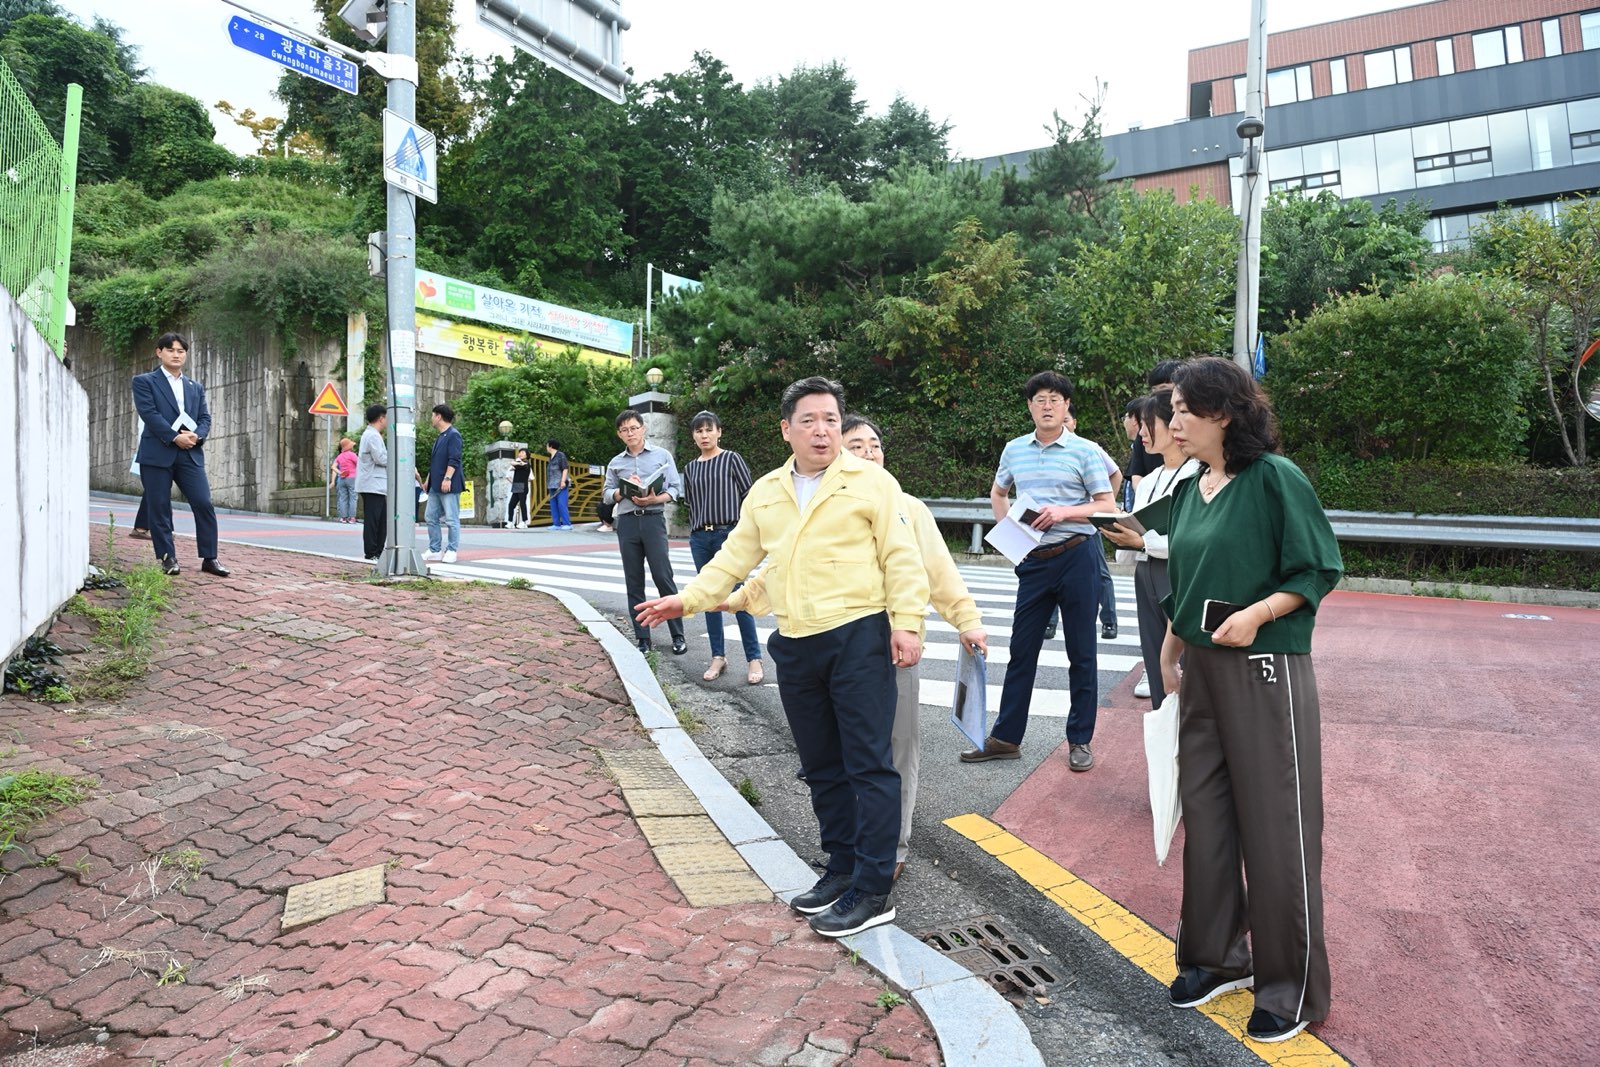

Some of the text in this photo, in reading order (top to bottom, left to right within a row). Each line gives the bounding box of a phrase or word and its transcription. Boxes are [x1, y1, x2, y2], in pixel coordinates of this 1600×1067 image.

[233, 22, 265, 41] 2 28
[271, 49, 353, 89] Gwangbongmaeul 3-gil
[281, 38, 353, 80] 광복마을3길
[463, 334, 499, 356] 행복한
